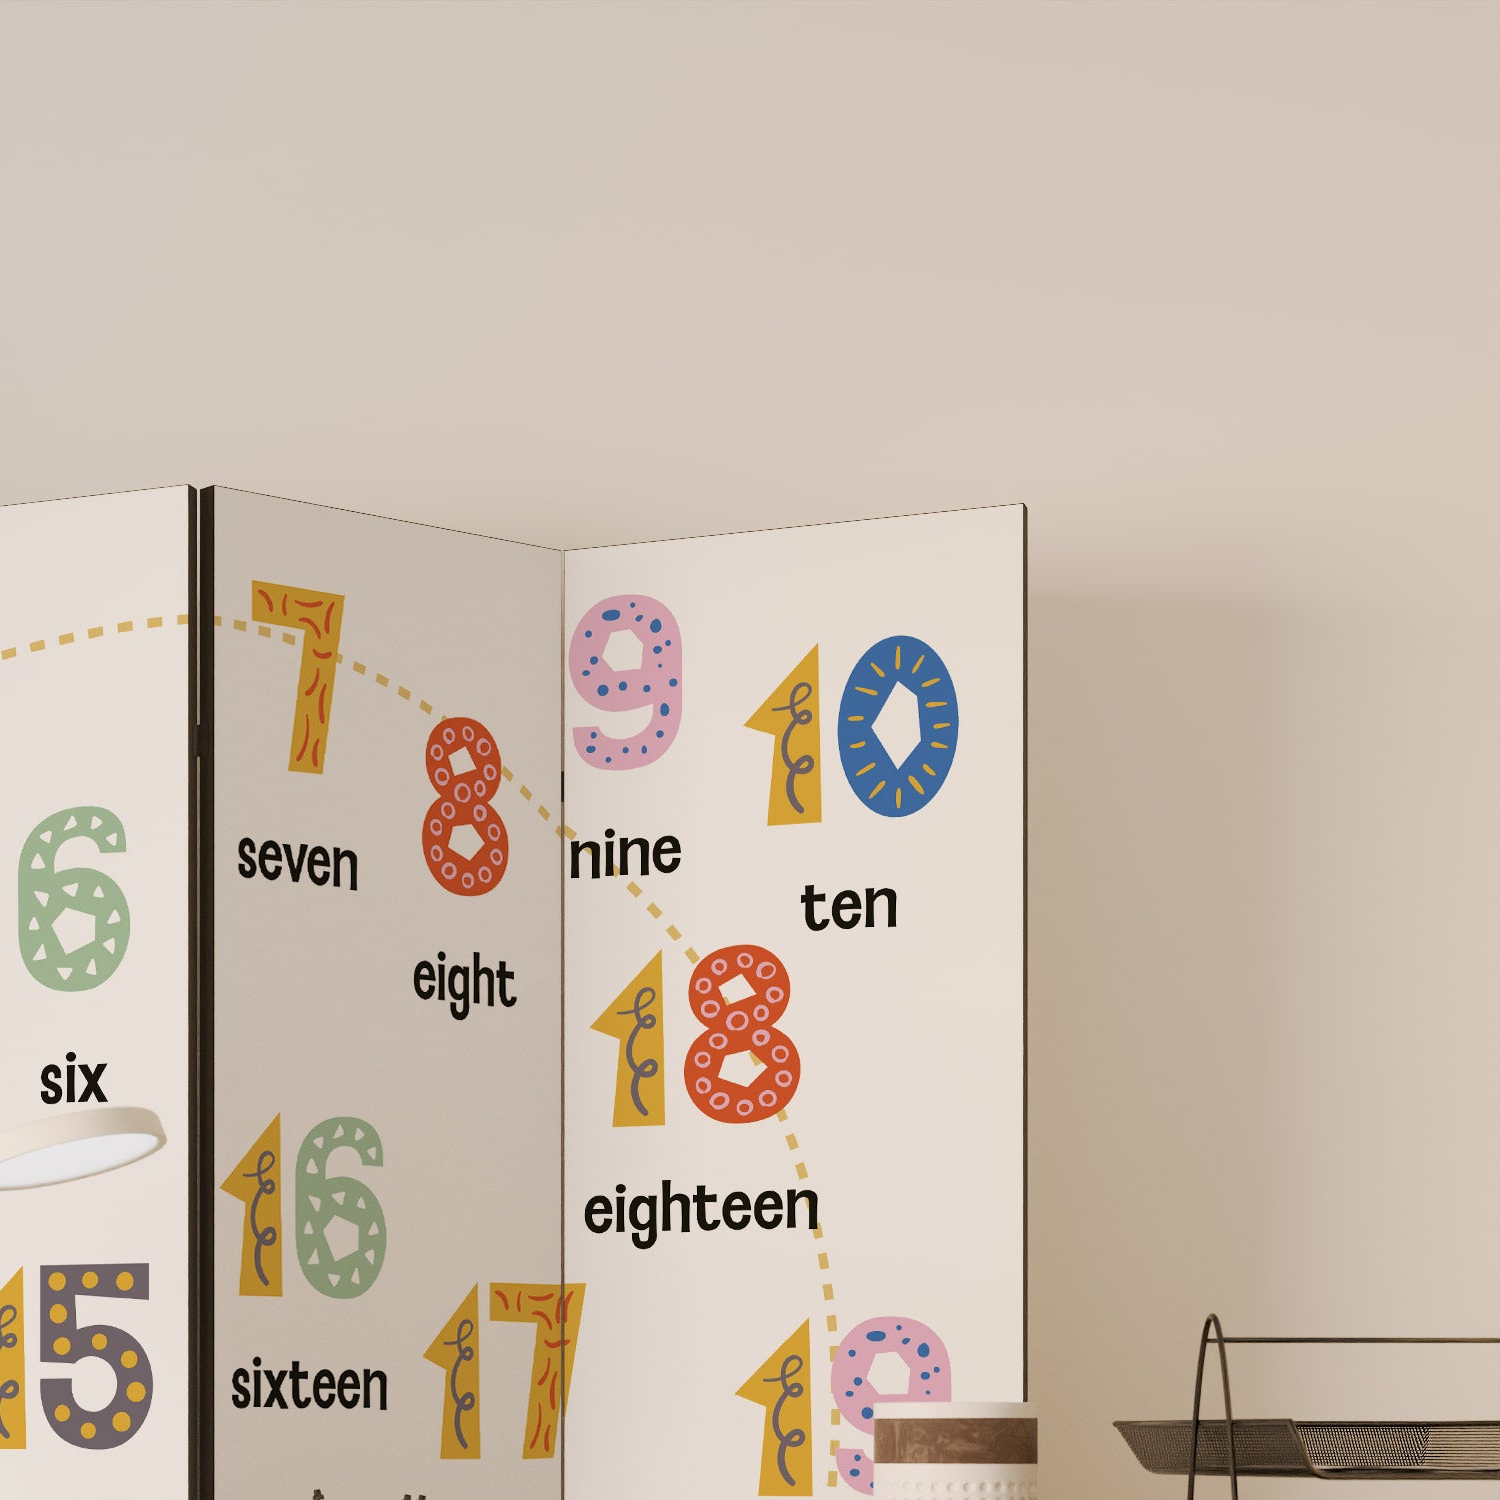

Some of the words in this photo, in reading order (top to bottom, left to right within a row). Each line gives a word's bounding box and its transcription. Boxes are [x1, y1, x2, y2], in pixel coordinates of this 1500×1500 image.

[252, 581, 344, 774] 7
[569, 595, 682, 770] 9
[745, 636, 959, 826] 10
[238, 837, 357, 890] seven
[423, 718, 508, 896] 8
[570, 828, 681, 878] nine
[18, 806, 130, 992] 6
[413, 951, 517, 1020] eight
[801, 885, 896, 931] ten
[40, 1051, 107, 1104] six
[591, 945, 800, 1127] 18
[221, 1115, 386, 1298] 16
[585, 1180, 818, 1249] eighteen
[231, 1357, 387, 1411] sixteen
[424, 1283, 585, 1459] 17
[736, 1316, 951, 1496] 19
